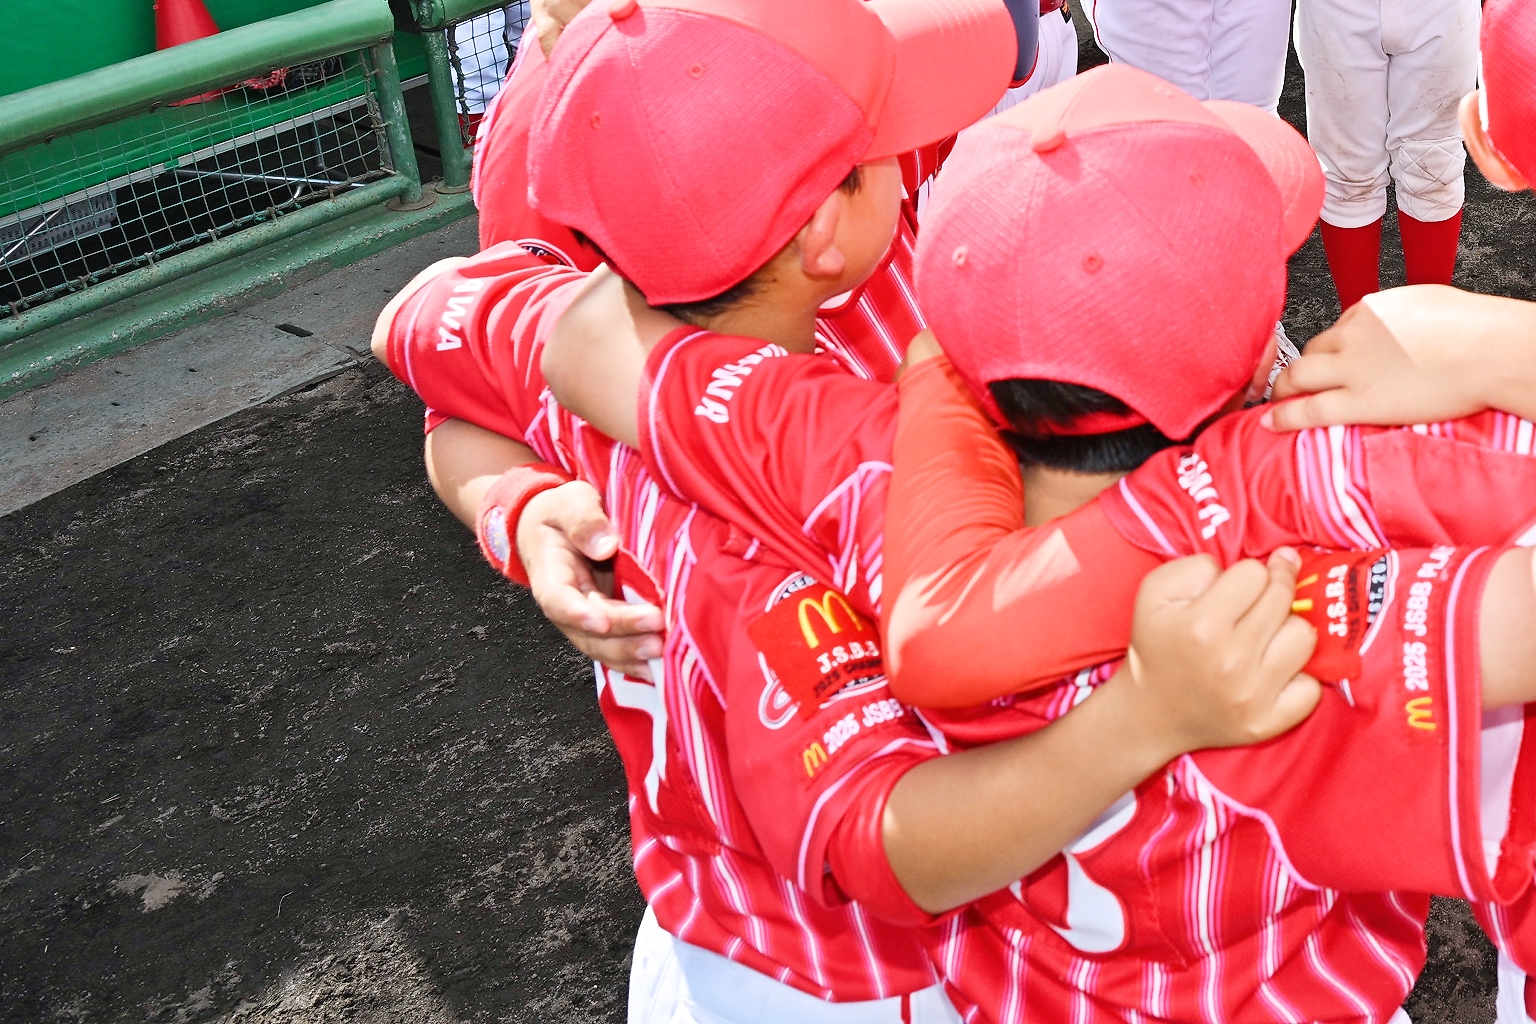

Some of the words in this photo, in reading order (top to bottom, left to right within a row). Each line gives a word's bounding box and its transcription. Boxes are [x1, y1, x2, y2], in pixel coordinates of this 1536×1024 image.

[1404, 580, 1433, 637] JSBB
[1403, 641, 1430, 692] 2025
[823, 712, 861, 756] 2025
